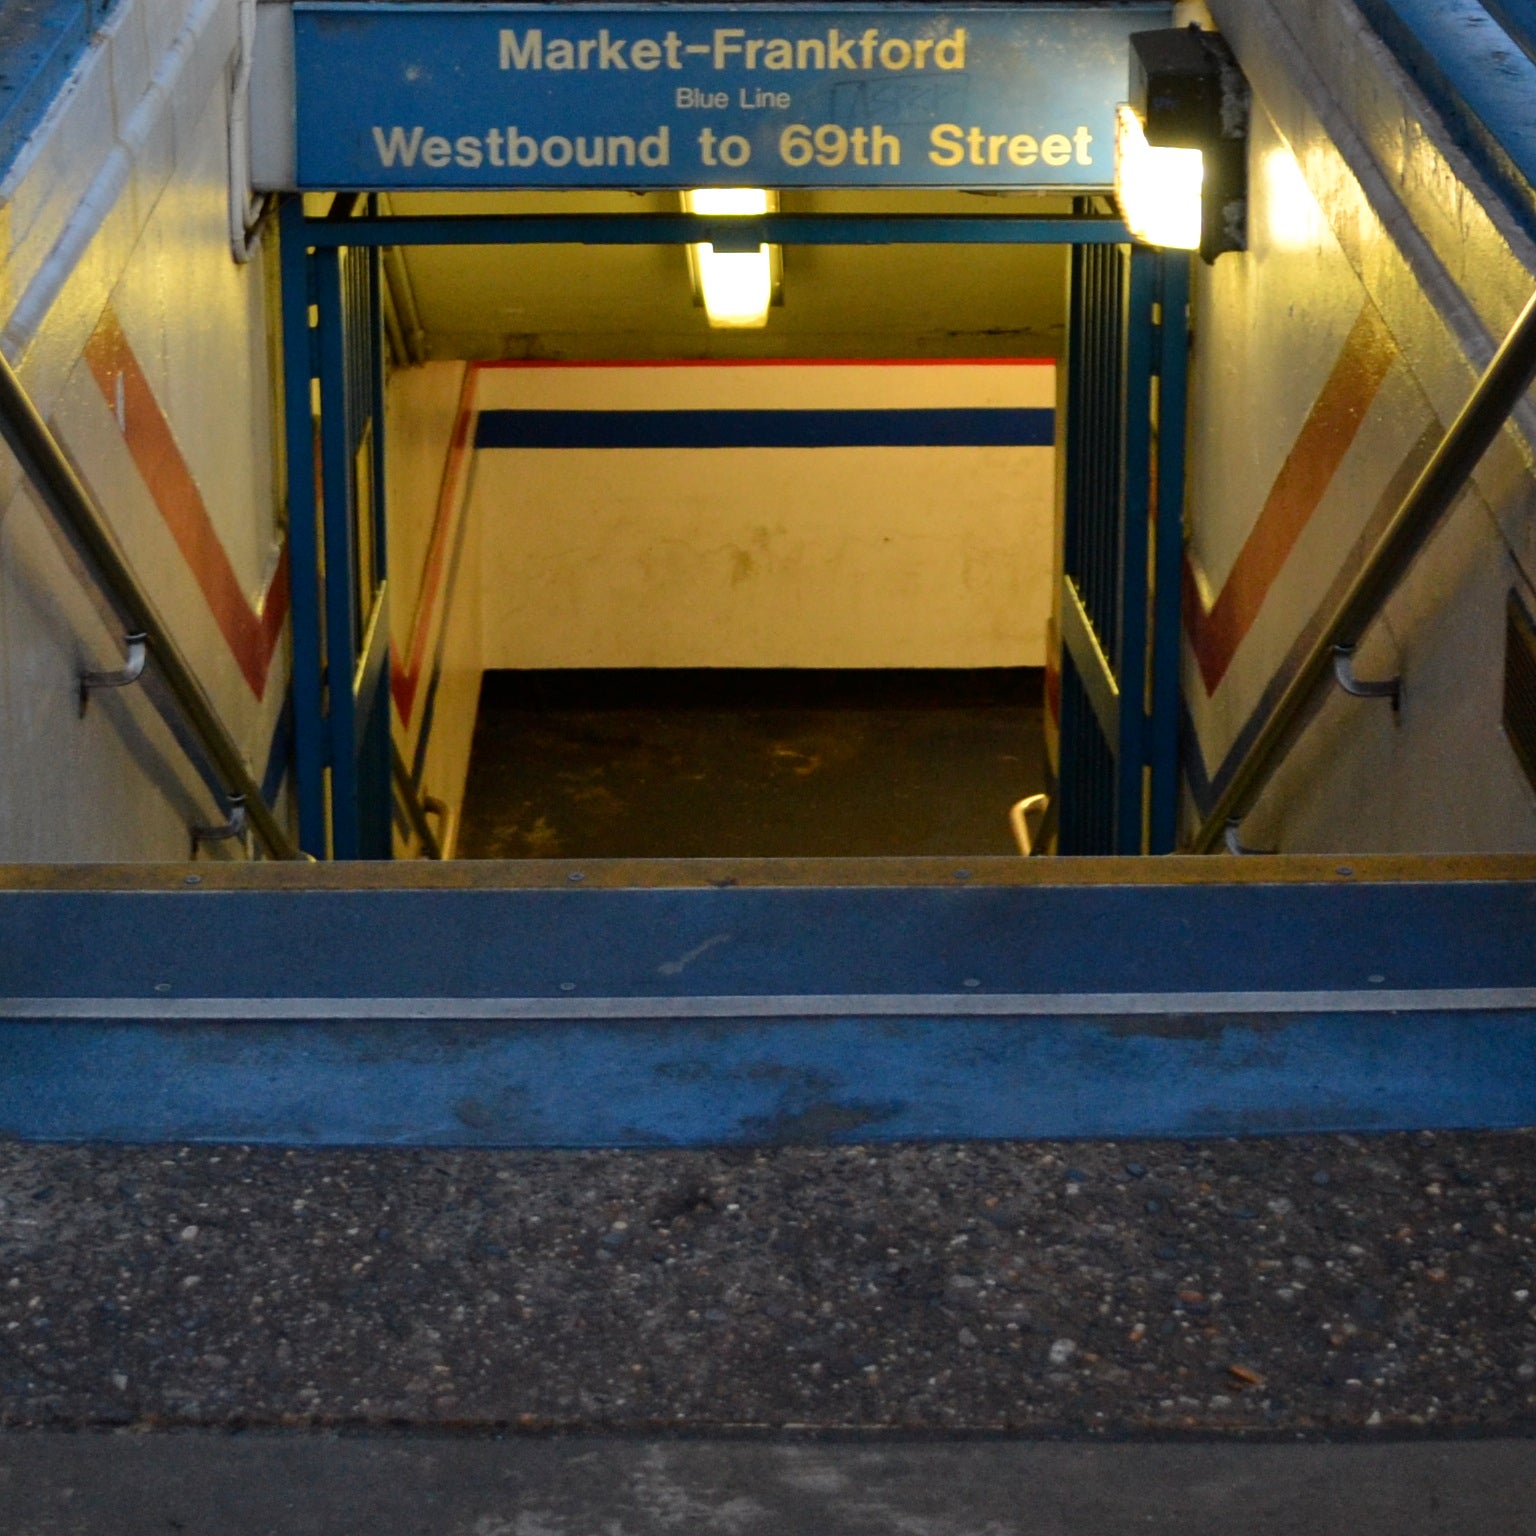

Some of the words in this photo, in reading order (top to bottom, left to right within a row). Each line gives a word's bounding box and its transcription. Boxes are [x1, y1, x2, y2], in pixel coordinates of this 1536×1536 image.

[499, 28, 966, 70] Market-Frankford
[675, 87, 729, 110] Blue
[739, 87, 792, 110] Line
[372, 126, 669, 167] Westbound
[699, 127, 752, 167] to
[780, 123, 901, 167] 69th
[928, 123, 1092, 167] Street
